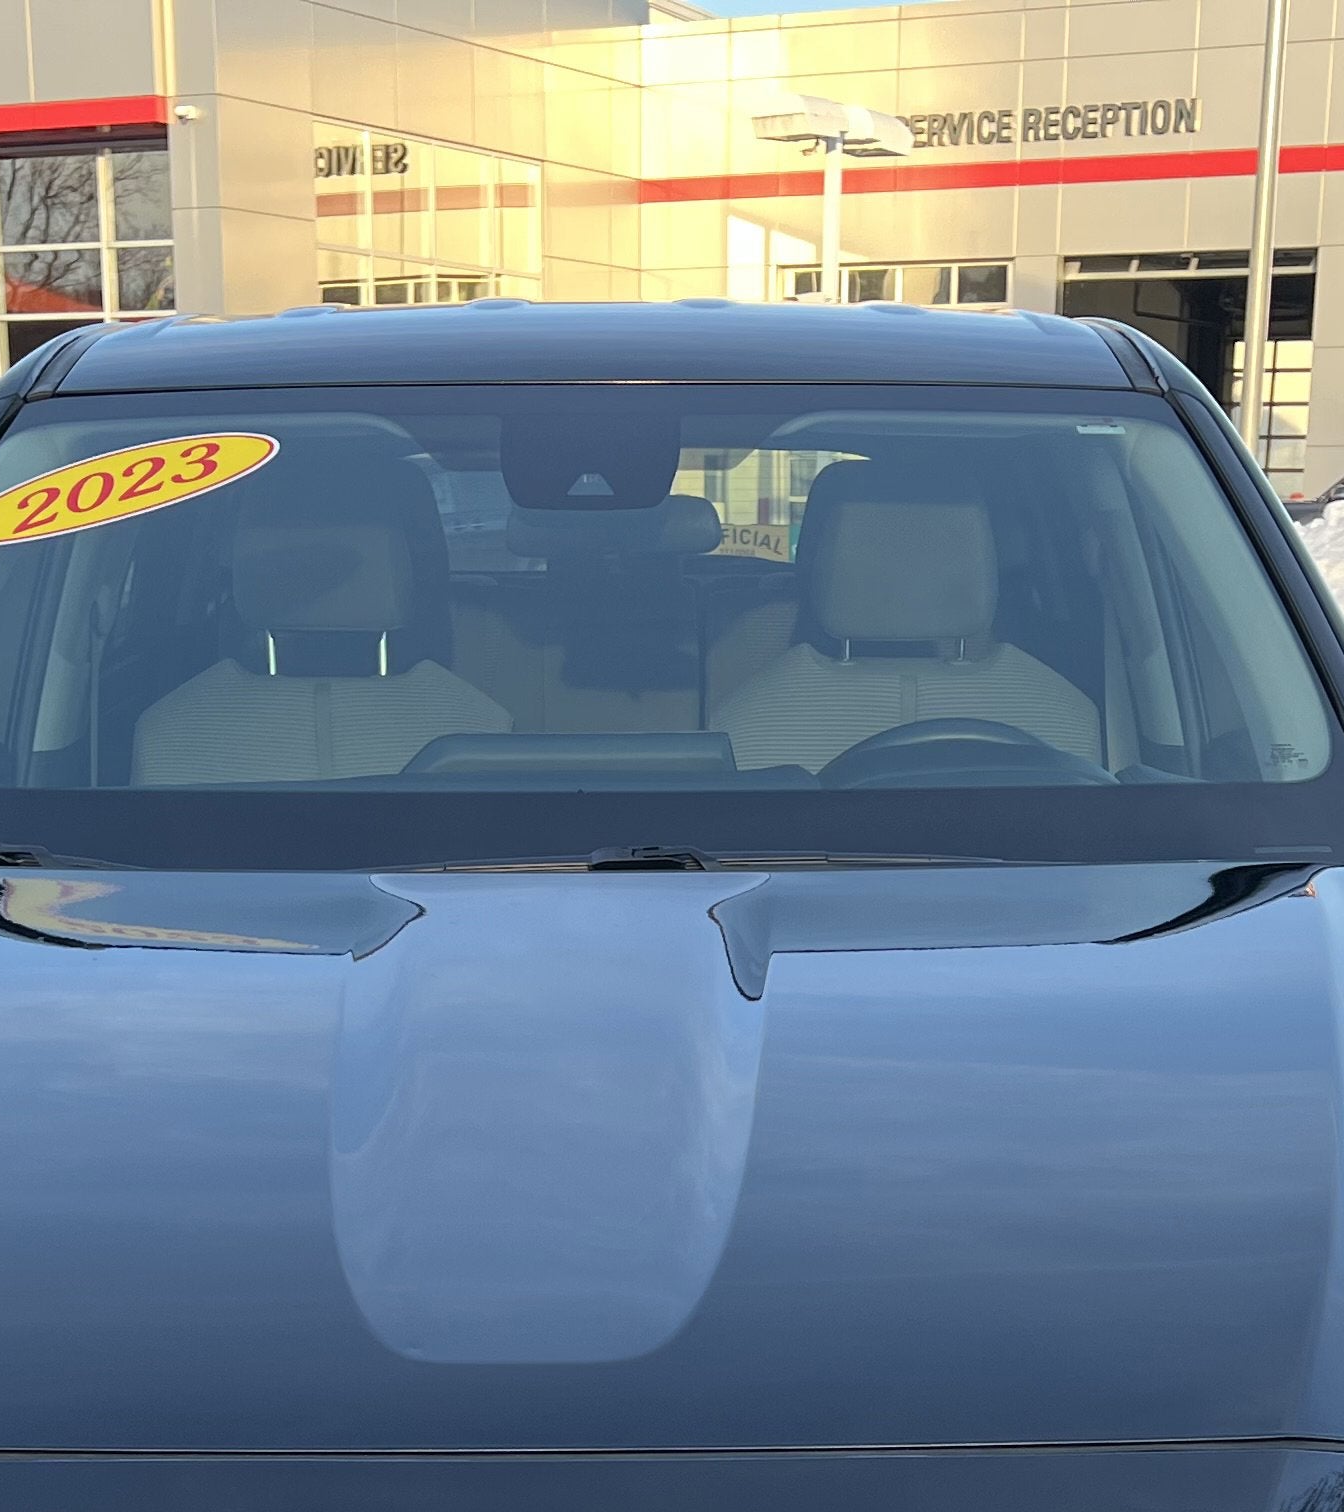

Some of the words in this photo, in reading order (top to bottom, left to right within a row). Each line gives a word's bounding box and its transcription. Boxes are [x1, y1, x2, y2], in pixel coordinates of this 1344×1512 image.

[896, 109, 1013, 147] ERVICE
[1022, 98, 1199, 142] RECEPTION
[12, 442, 220, 534] 2023
